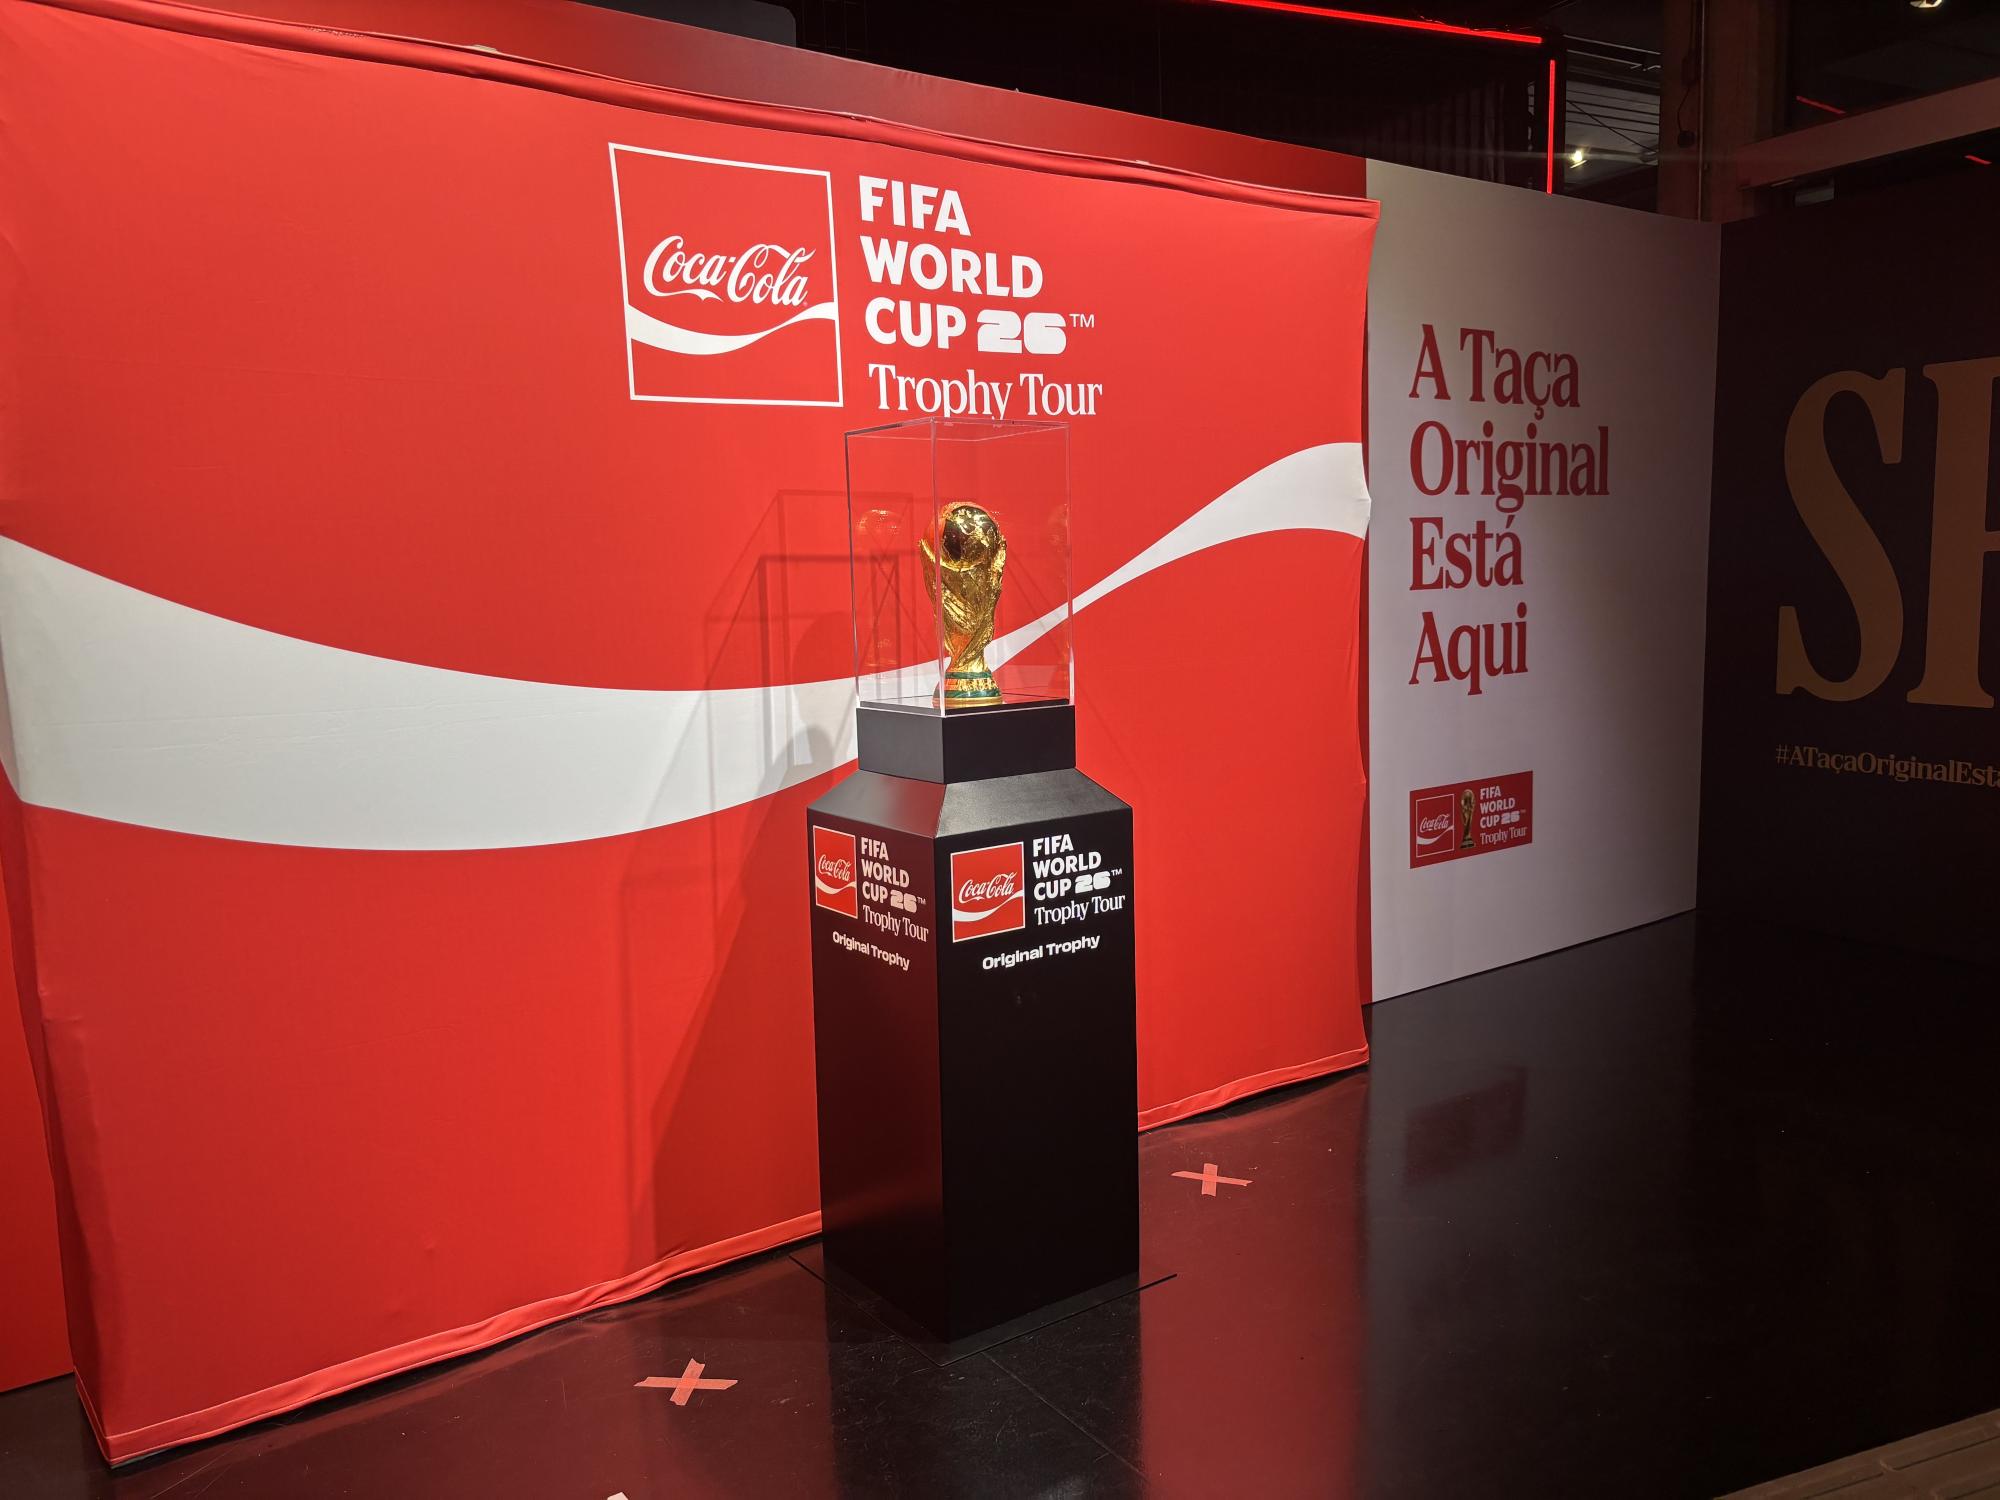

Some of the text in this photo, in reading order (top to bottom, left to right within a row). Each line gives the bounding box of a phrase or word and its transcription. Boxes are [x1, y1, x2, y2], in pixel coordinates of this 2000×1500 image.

[859, 174, 971, 237] FIFA
[643, 235, 816, 307] Coca-Cola
[860, 235, 1044, 299] WORLD
[865, 297, 966, 349] CUP
[1408, 323, 1580, 420] A Taça
[868, 363, 1103, 420] Trophy Tour
[1409, 420, 1610, 513] Original
[1409, 514, 1523, 591] Está
[1408, 601, 1528, 696] Aqui
[1480, 785, 1501, 800] FIFA
[1480, 797, 1515, 814] WORLD
[1480, 814, 1500, 829] CUP
[1480, 826, 1527, 845] Trophy Tour
[861, 836, 889, 860] FIFA
[1032, 834, 1074, 857] FIFA
[818, 854, 852, 881] Coca-Cola
[861, 859, 910, 888] WORLD
[1032, 851, 1102, 879] WORLD
[862, 881, 888, 903] CUP
[958, 872, 1017, 904] Coca-Cola
[1033, 878, 1071, 901] CUP
[863, 905, 929, 942] Trophy Tour
[1034, 895, 1125, 925] Trophy Tour
[832, 931, 910, 971] Original Trophy
[982, 935, 1100, 970] Original Trophy
